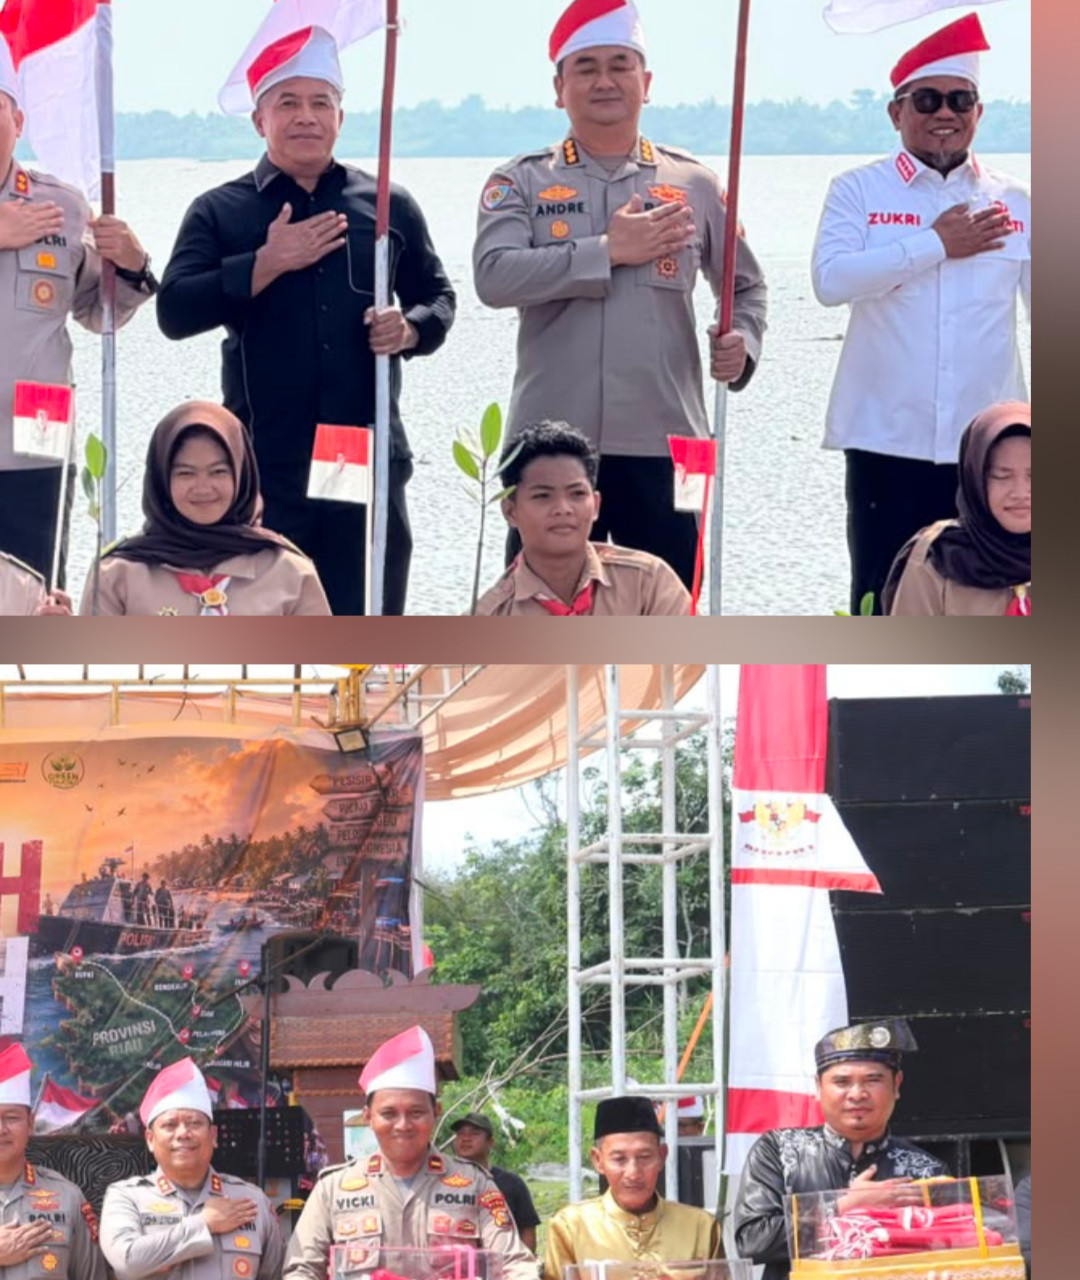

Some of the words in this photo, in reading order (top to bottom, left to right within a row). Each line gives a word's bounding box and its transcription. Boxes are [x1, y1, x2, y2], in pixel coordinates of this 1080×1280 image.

[535, 202, 585, 217] ANDRE
[868, 212, 921, 226] ZUKRI
[93, 1020, 157, 1046] PROVINSI
[109, 1040, 143, 1057] RIAU
[336, 1195, 375, 1210] VICKI
[435, 1193, 477, 1206] POLRI
